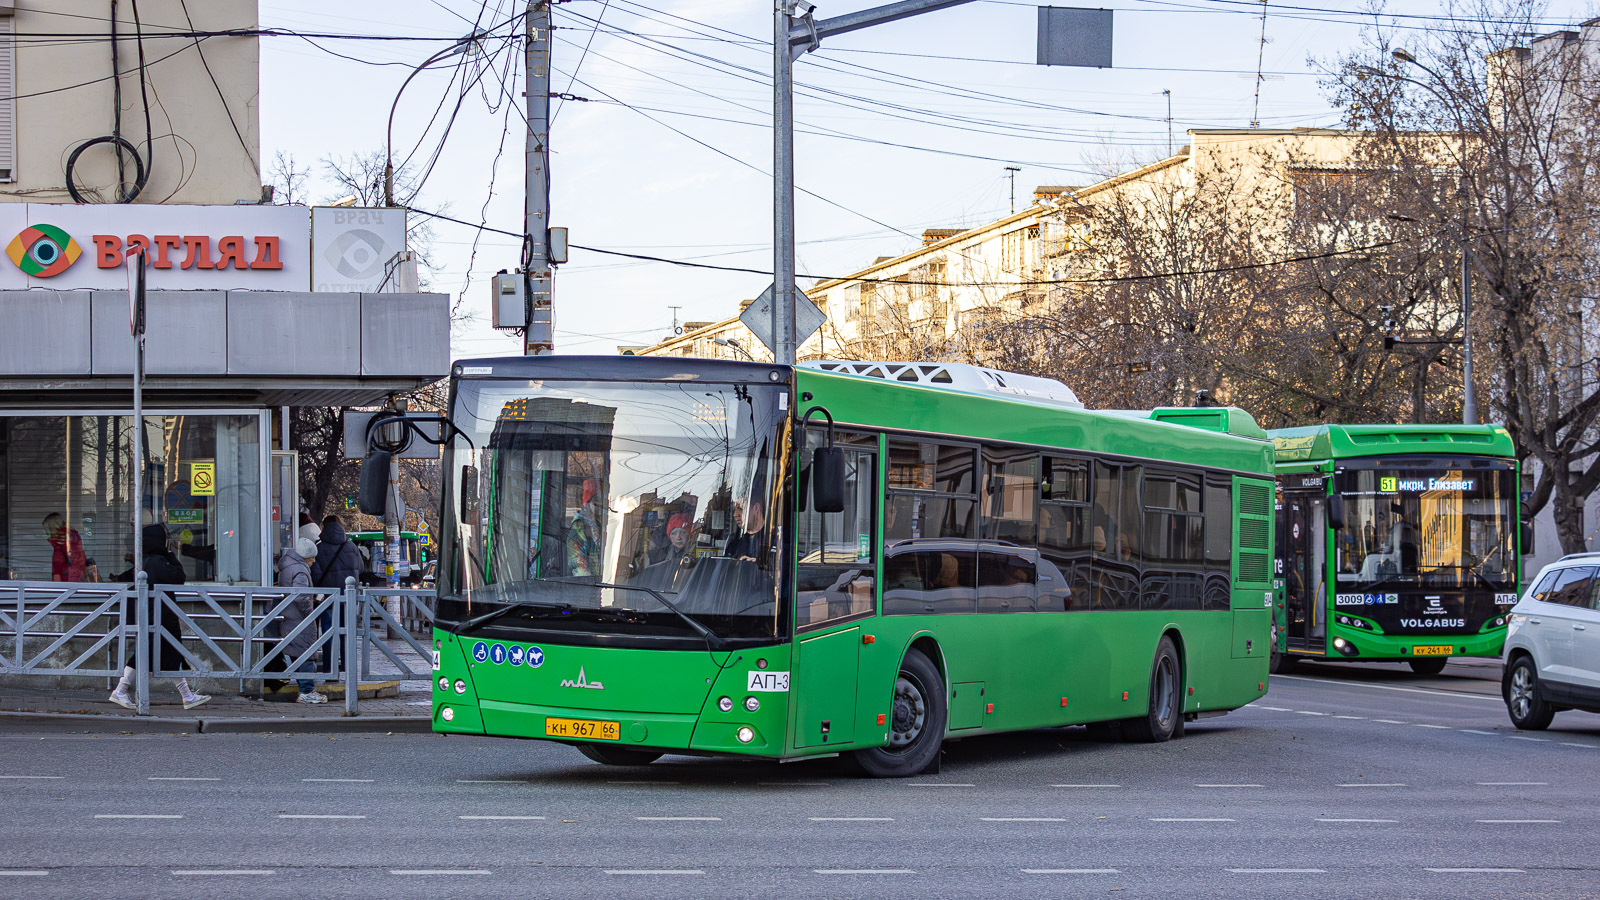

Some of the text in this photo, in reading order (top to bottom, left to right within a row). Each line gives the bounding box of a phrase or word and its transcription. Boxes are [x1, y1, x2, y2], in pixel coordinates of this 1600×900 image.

[1302, 478, 1323, 487] VOLGABU
[1382, 477, 1473, 492] 51 мкрн. Елизавет
[1338, 594, 1363, 605] 3009
[1496, 594, 1517, 604] АП-6
[1400, 618, 1465, 628] VOLGABUS
[1427, 647, 1440, 656] 241
[750, 673, 789, 690] АП-3
[572, 722, 596, 736] 967
[603, 723, 615, 734] 66
